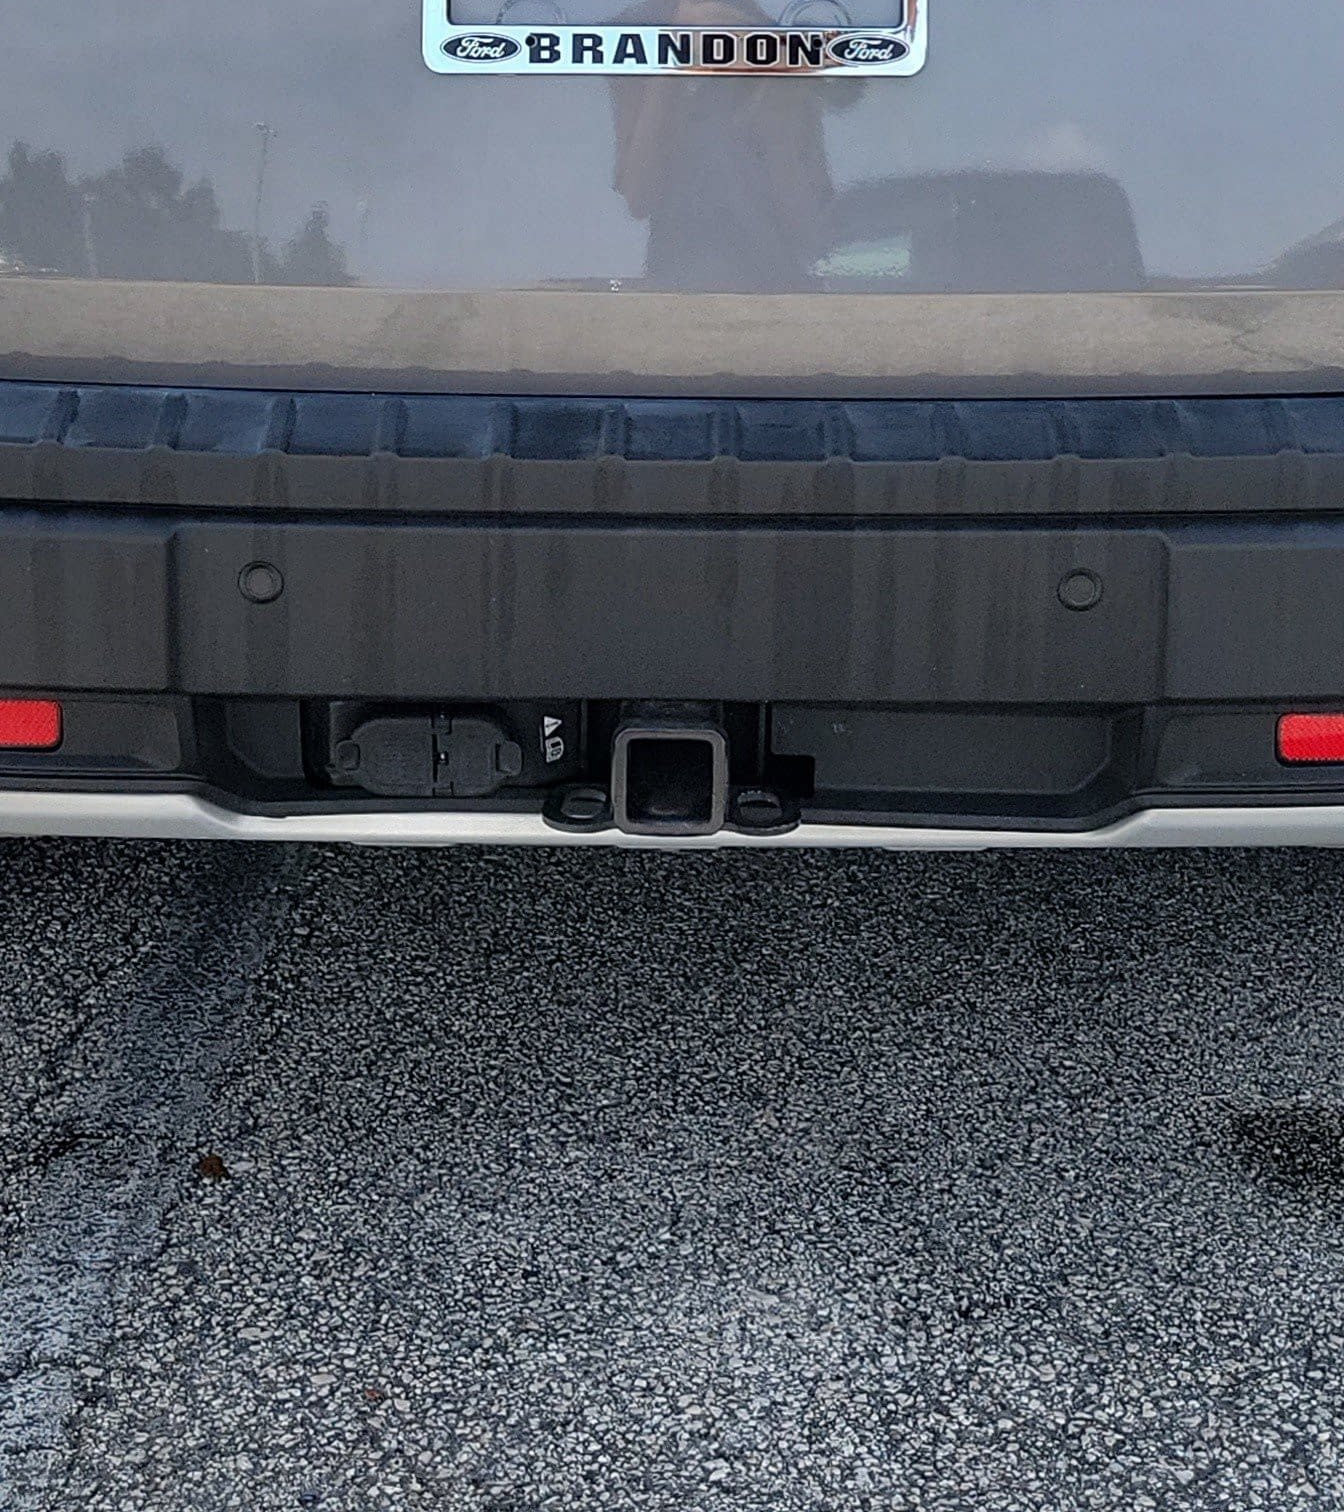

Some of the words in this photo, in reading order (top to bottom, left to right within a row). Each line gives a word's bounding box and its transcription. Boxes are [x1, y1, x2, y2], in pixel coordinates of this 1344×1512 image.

[455, 37, 507, 59] Ford
[527, 33, 825, 67] BRANDON
[843, 39, 895, 61] Ford
